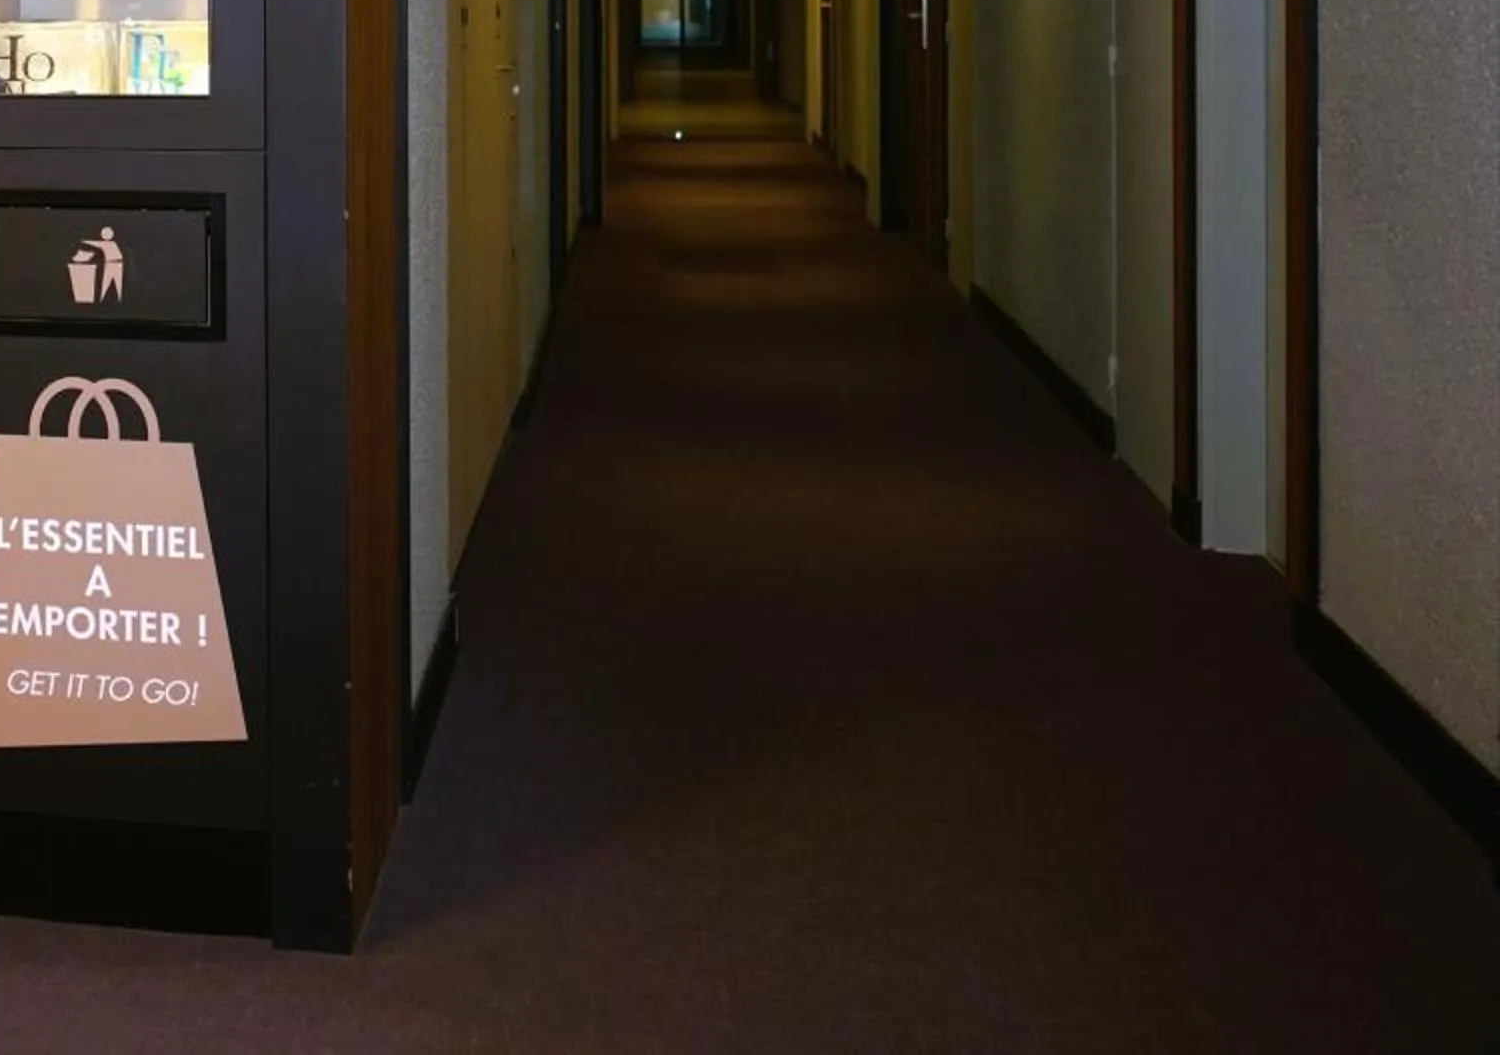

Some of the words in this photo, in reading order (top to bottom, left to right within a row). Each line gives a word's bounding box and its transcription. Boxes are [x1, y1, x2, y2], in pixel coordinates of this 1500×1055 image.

[84, 563, 112, 598] A
[197, 613, 208, 648] !
[6, 668, 61, 697] GET
[66, 673, 90, 699] IT
[97, 674, 134, 702] TO
[141, 677, 200, 707] GO!
